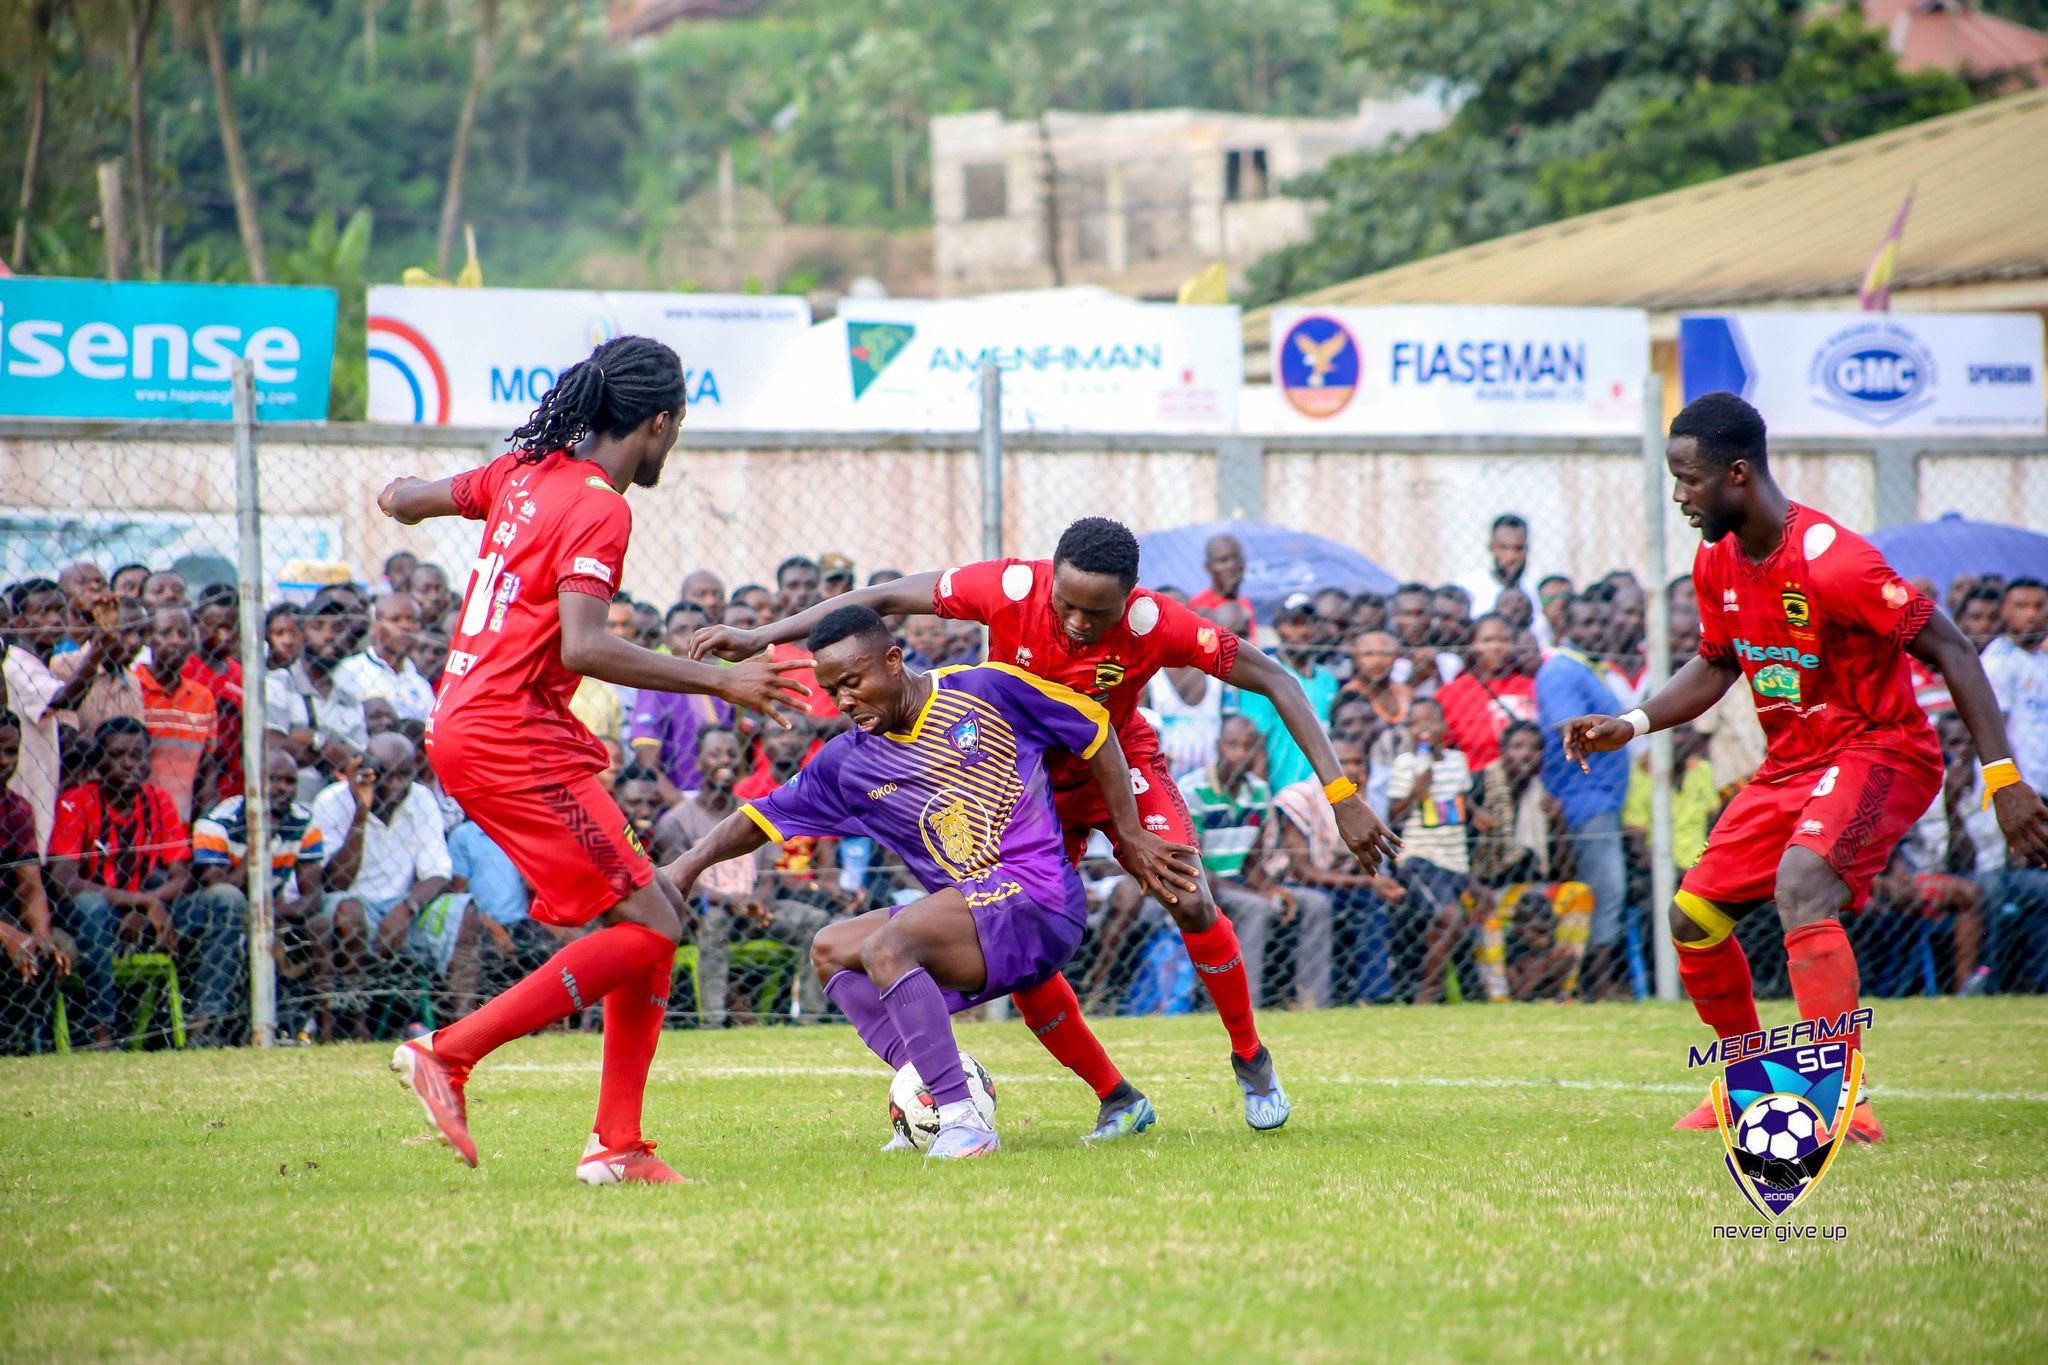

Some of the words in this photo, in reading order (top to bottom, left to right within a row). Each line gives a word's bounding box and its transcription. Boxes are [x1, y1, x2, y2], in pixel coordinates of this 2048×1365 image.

[0, 299, 300, 383] sense
[1391, 341, 1585, 384] FIASEMAN
[1836, 356, 1917, 394] GMC
